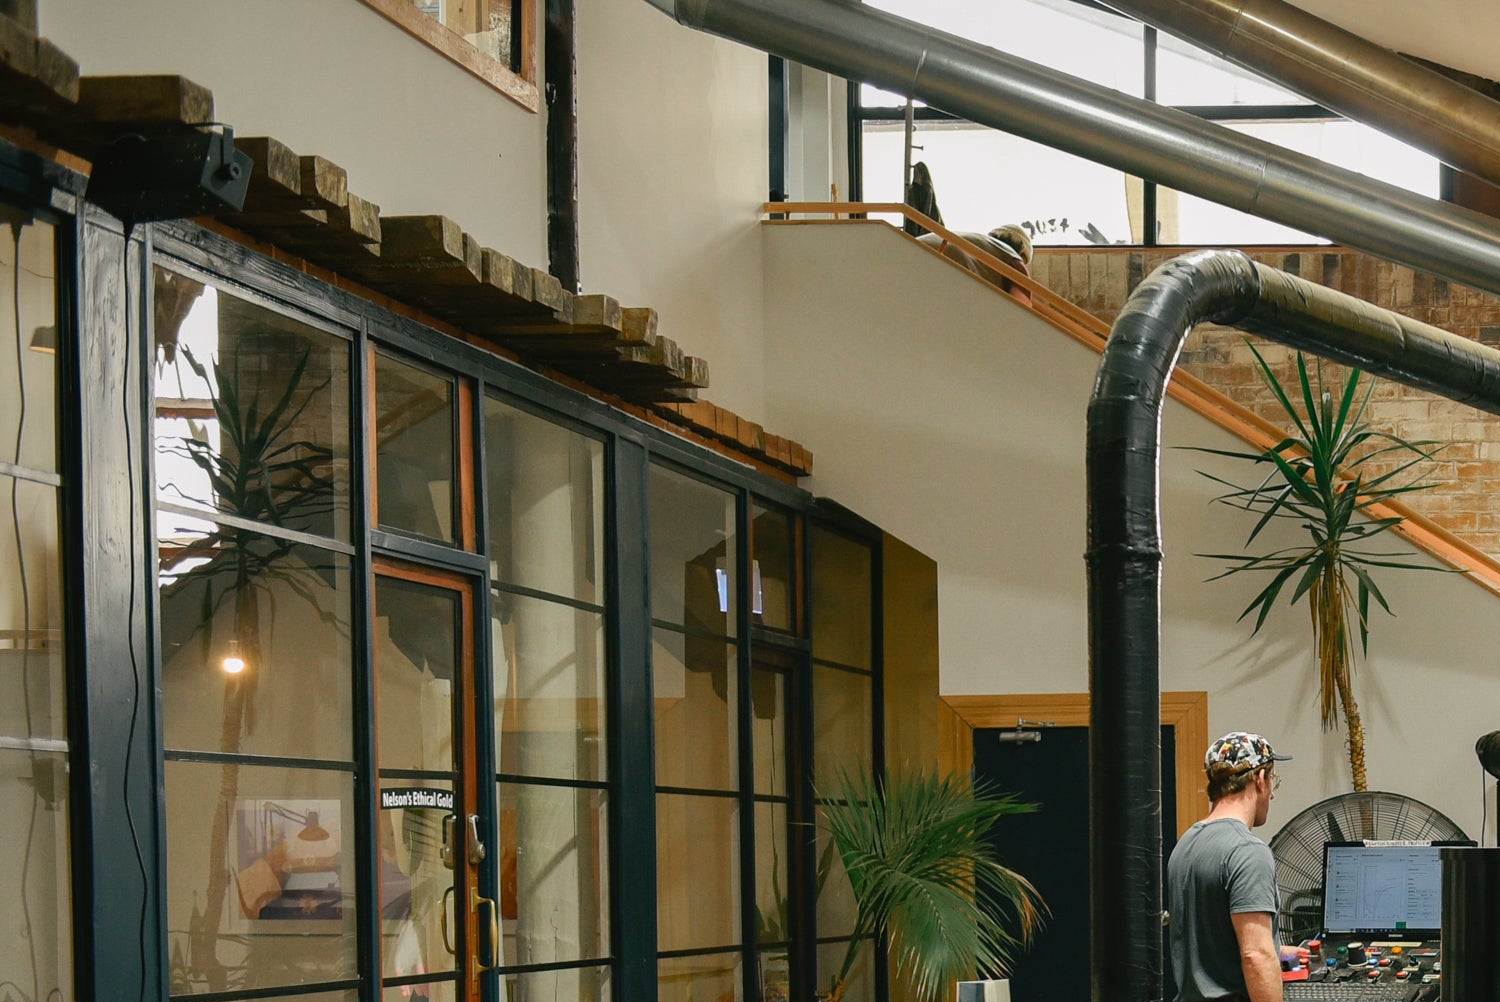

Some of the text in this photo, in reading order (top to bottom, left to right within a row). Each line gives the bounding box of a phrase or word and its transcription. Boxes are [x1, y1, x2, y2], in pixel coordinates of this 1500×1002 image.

[382, 791, 453, 808] Nelson's Ethical Gold
